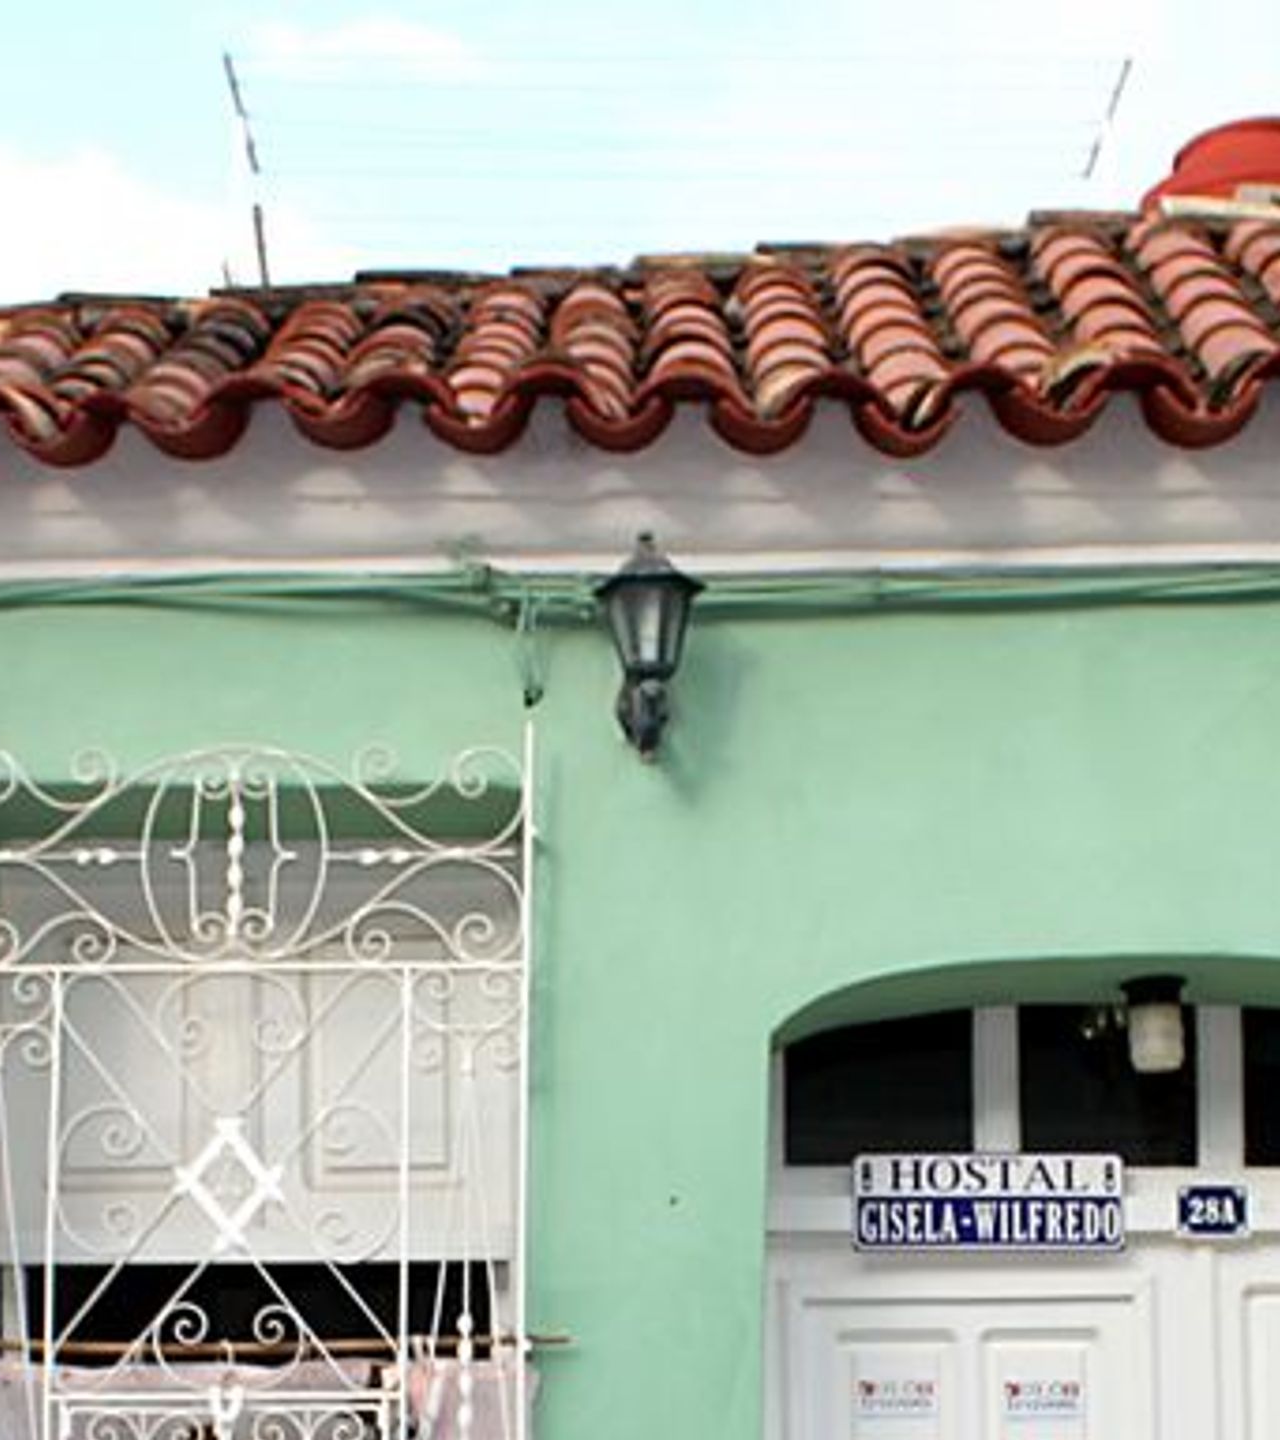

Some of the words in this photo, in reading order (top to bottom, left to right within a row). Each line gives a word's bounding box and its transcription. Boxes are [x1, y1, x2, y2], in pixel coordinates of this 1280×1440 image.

[890, 1159, 1089, 1191] HOSTAL
[860, 1201, 1120, 1241] GISELA-WILFREDO
[1187, 1196, 1237, 1225] 28A
